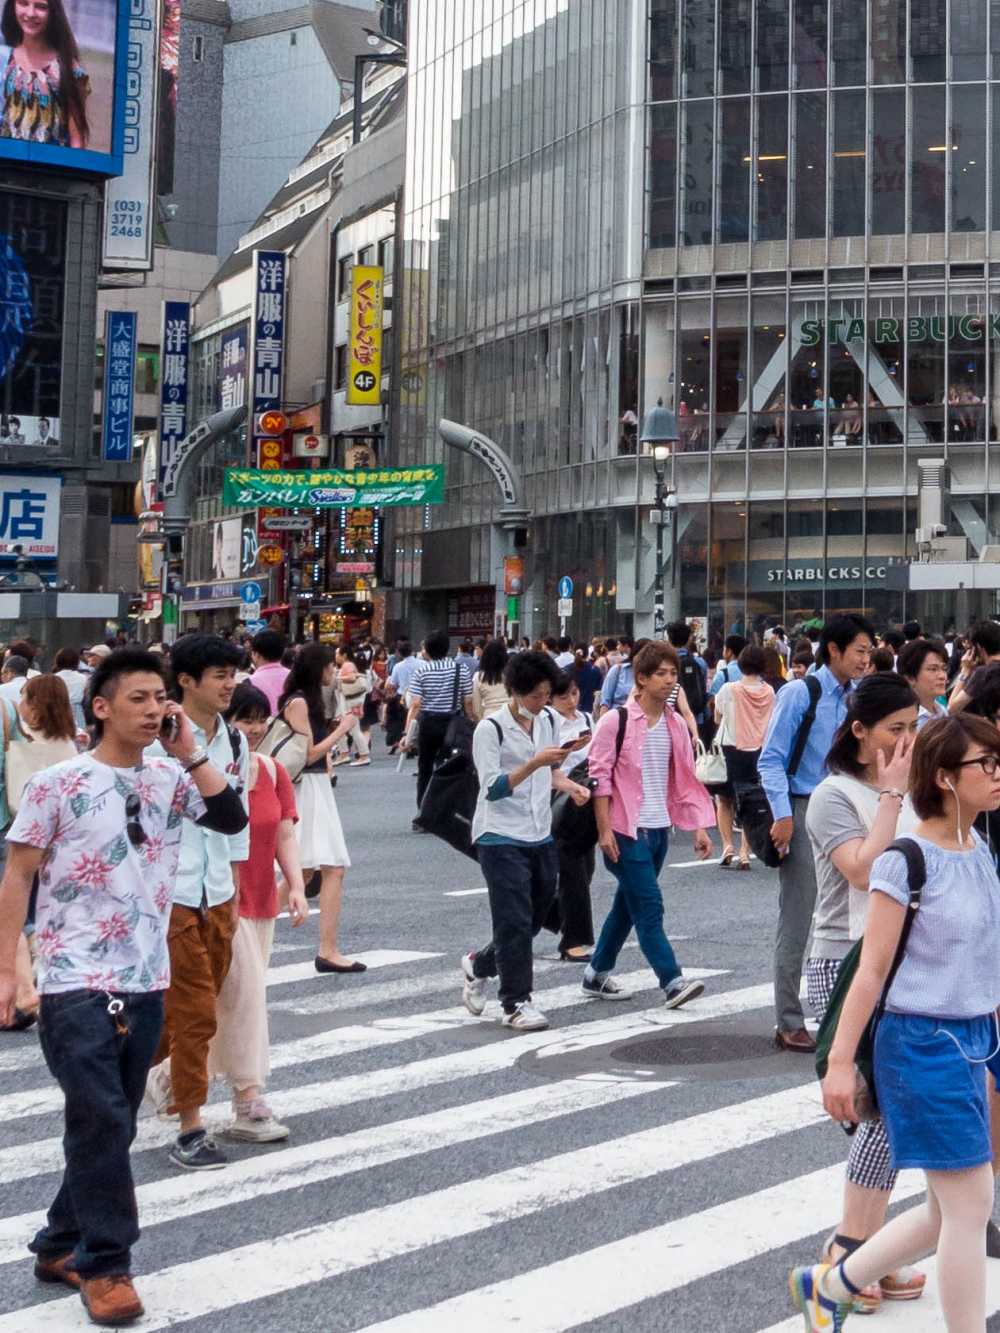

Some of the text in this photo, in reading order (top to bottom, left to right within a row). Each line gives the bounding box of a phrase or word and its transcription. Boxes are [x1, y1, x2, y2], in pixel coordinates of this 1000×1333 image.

[114, 200, 141, 213] (03)
[111, 214, 142, 226] 3719
[111, 226, 142, 238] 2468
[255, 260, 283, 399] 洋服の青山
[108, 321, 132, 451] 大盛堂商事ビル
[354, 374, 375, 388] 4F
[161, 320, 187, 467] 洋服の青山
[768, 567, 860, 581] STARBUCKS
